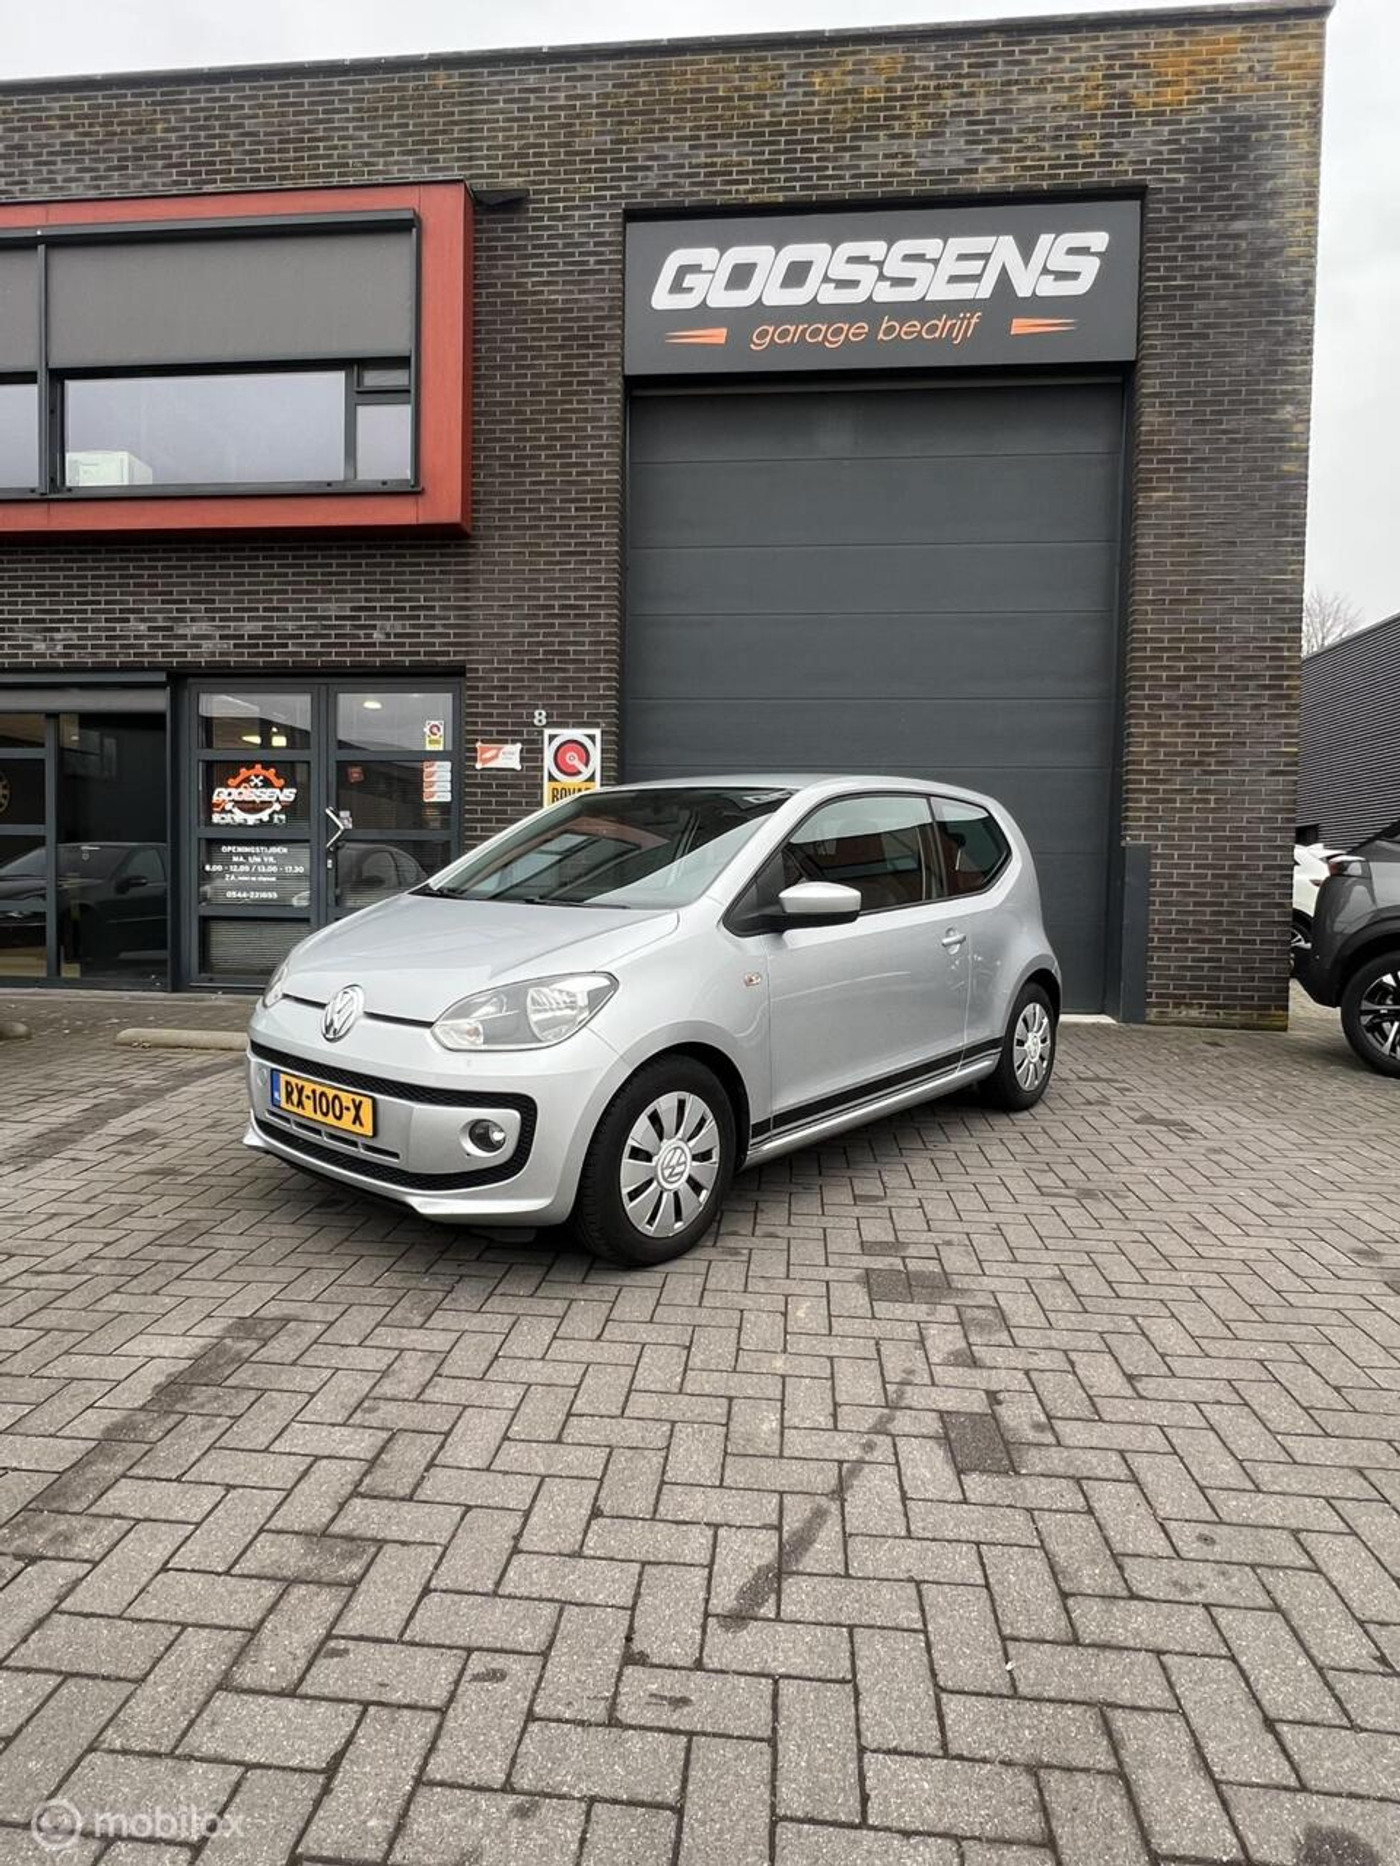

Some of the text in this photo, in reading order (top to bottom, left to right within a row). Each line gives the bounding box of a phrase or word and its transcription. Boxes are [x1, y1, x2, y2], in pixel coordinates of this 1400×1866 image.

[651, 231, 1110, 310] GOOSSENS
[749, 312, 982, 351] garage bedrijf
[533, 709, 547, 726] 8
[211, 787, 297, 802] GOOSSENS
[221, 845, 288, 854] OPENINGSTIJDEN
[285, 1080, 364, 1128] RX-100-X
